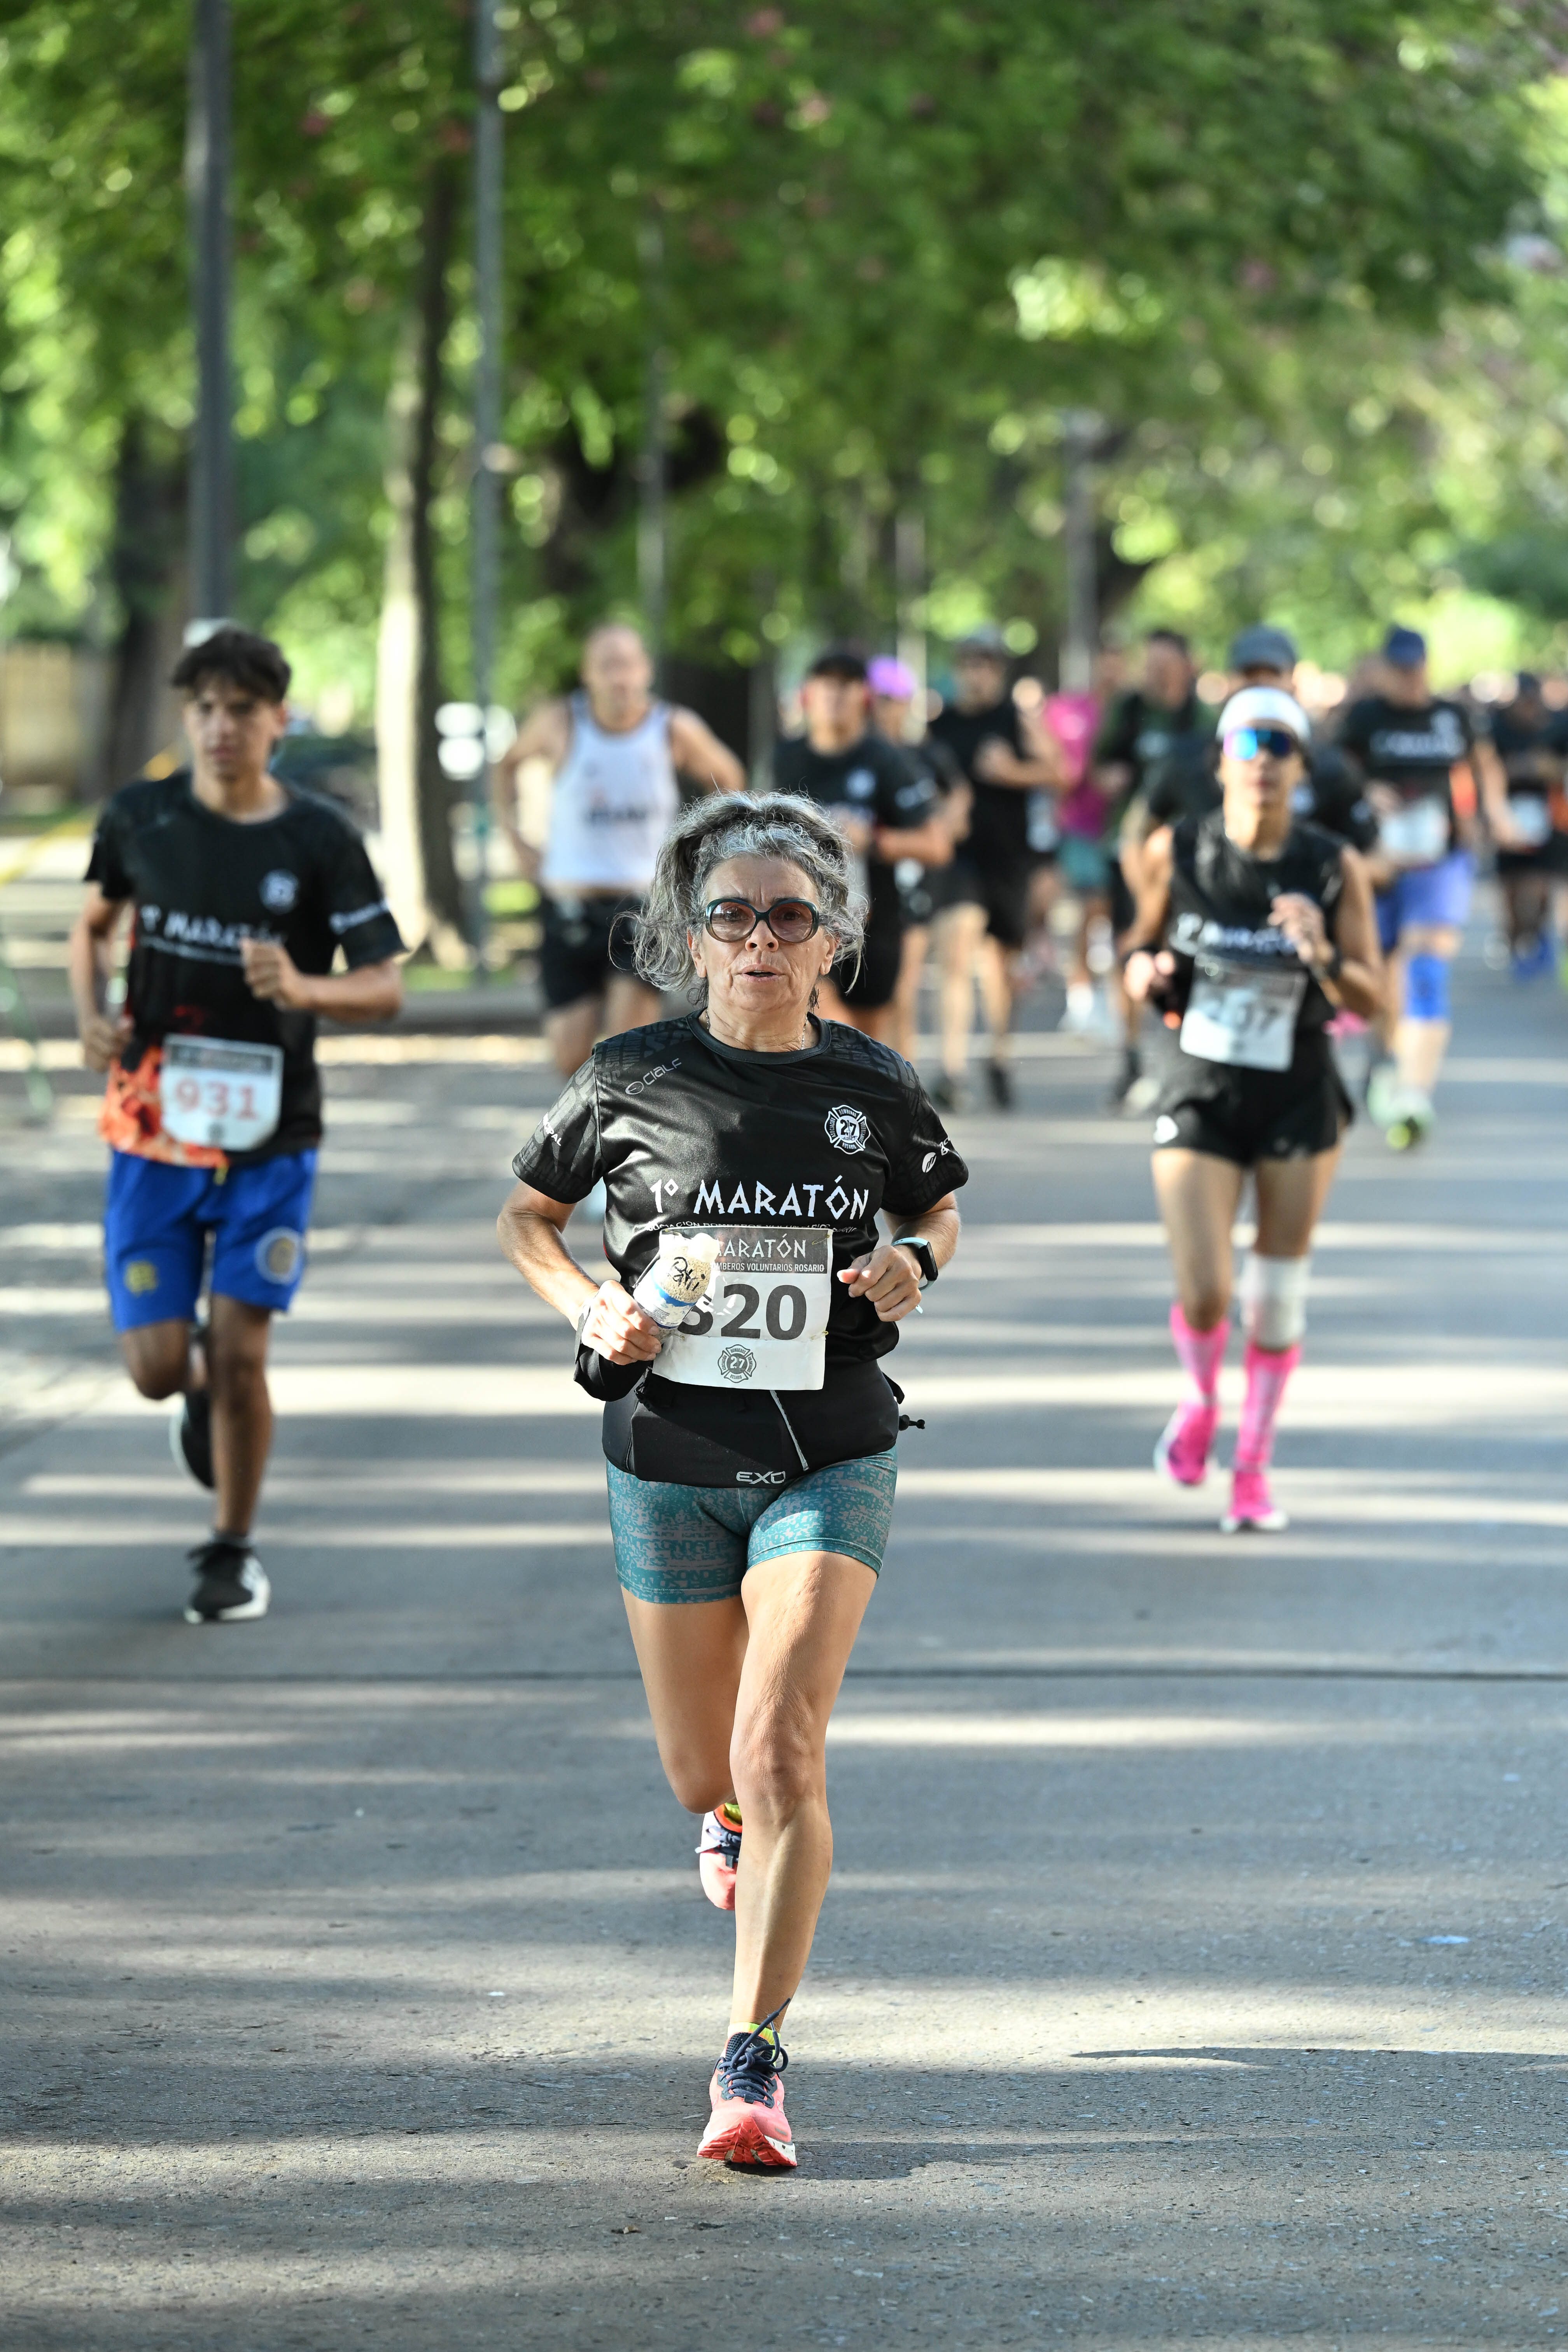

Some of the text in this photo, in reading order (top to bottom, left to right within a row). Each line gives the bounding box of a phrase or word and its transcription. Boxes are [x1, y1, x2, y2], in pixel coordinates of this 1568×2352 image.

[174, 1077, 259, 1121] 931
[838, 1109, 857, 1117] BOMBEROS
[840, 1119, 857, 1136] 27
[693, 1175, 869, 1220] MARATÓN
[717, 1233, 806, 1258] ARATÓN
[747, 1263, 793, 1272] VOLUNTARIOS
[794, 1264, 824, 1272] ROSARIO
[730, 1356, 745, 1368] 27
